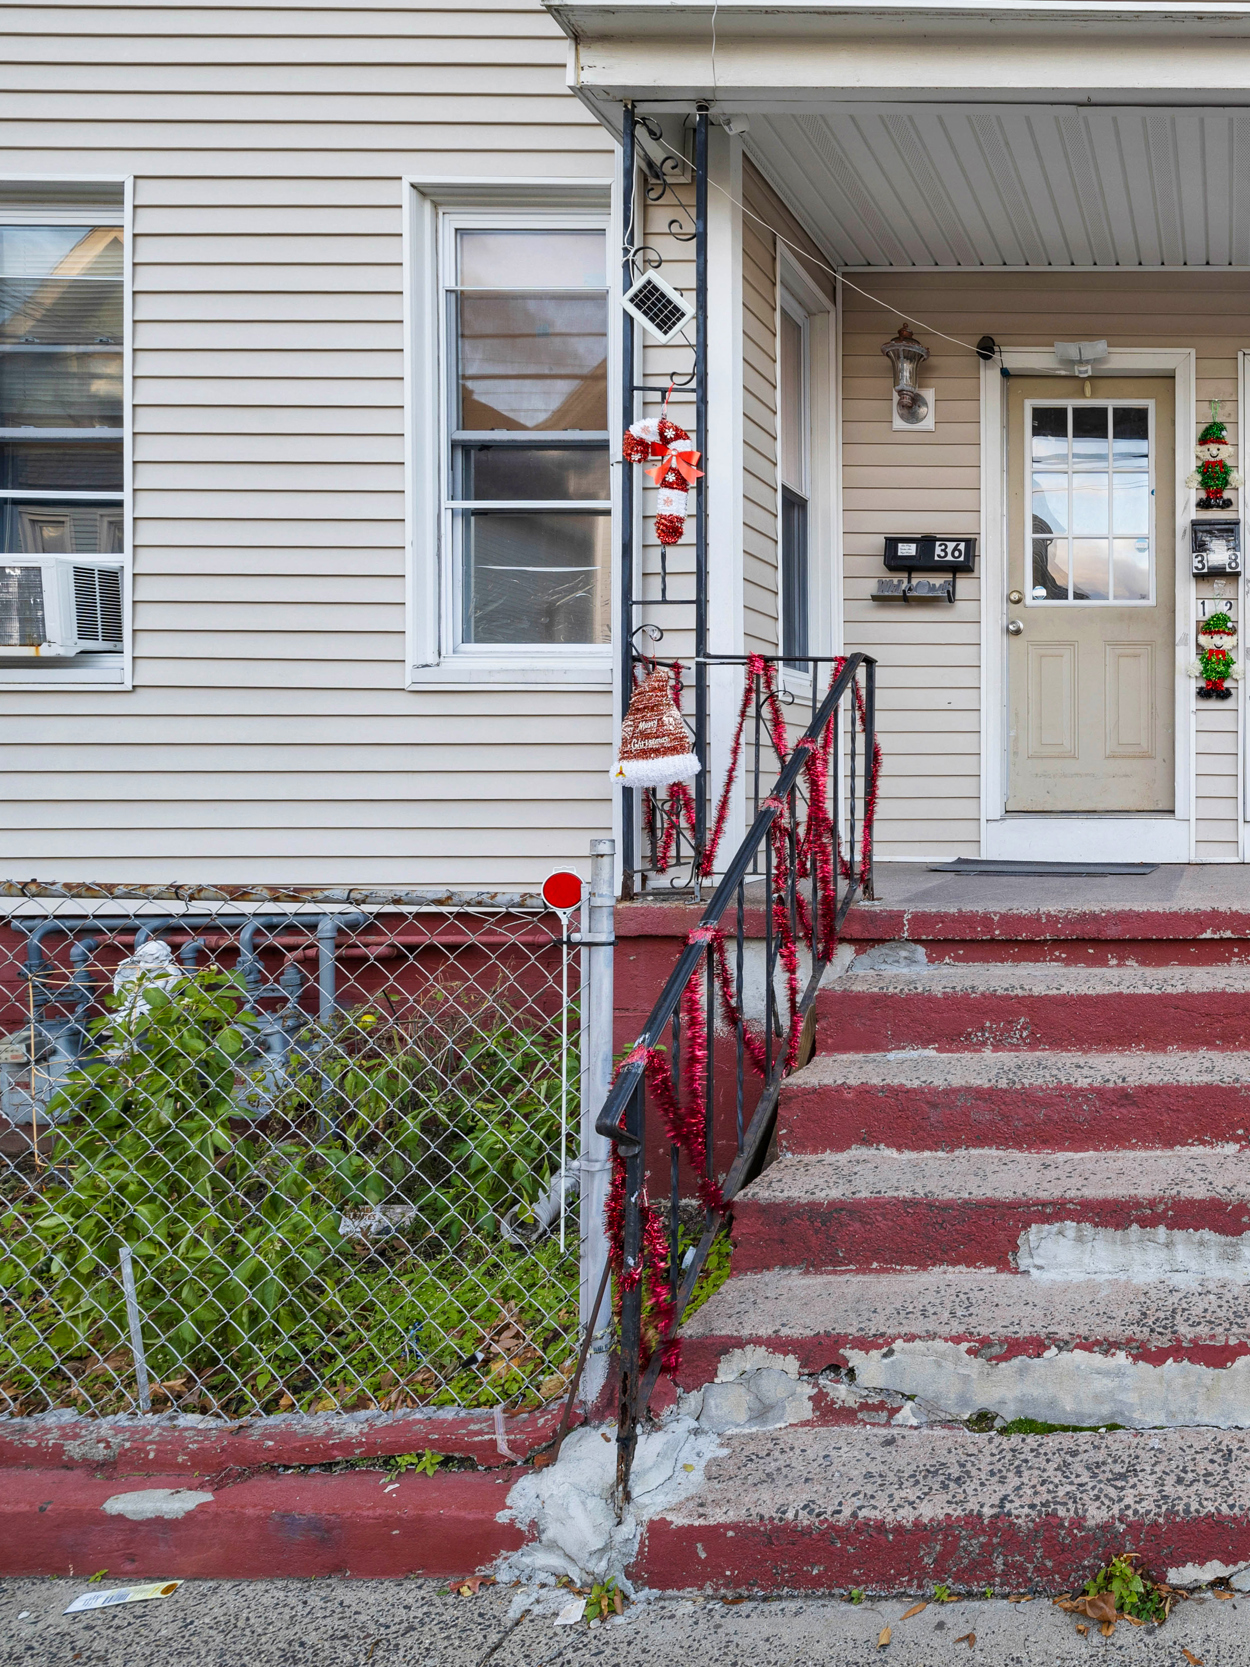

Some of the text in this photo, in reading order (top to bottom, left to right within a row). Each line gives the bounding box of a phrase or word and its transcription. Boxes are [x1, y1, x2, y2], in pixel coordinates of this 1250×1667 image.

[936, 543, 963, 559] 36
[1194, 553, 1240, 571] 3 8
[1201, 600, 1206, 617] 1
[637, 719, 658, 731] Merry
